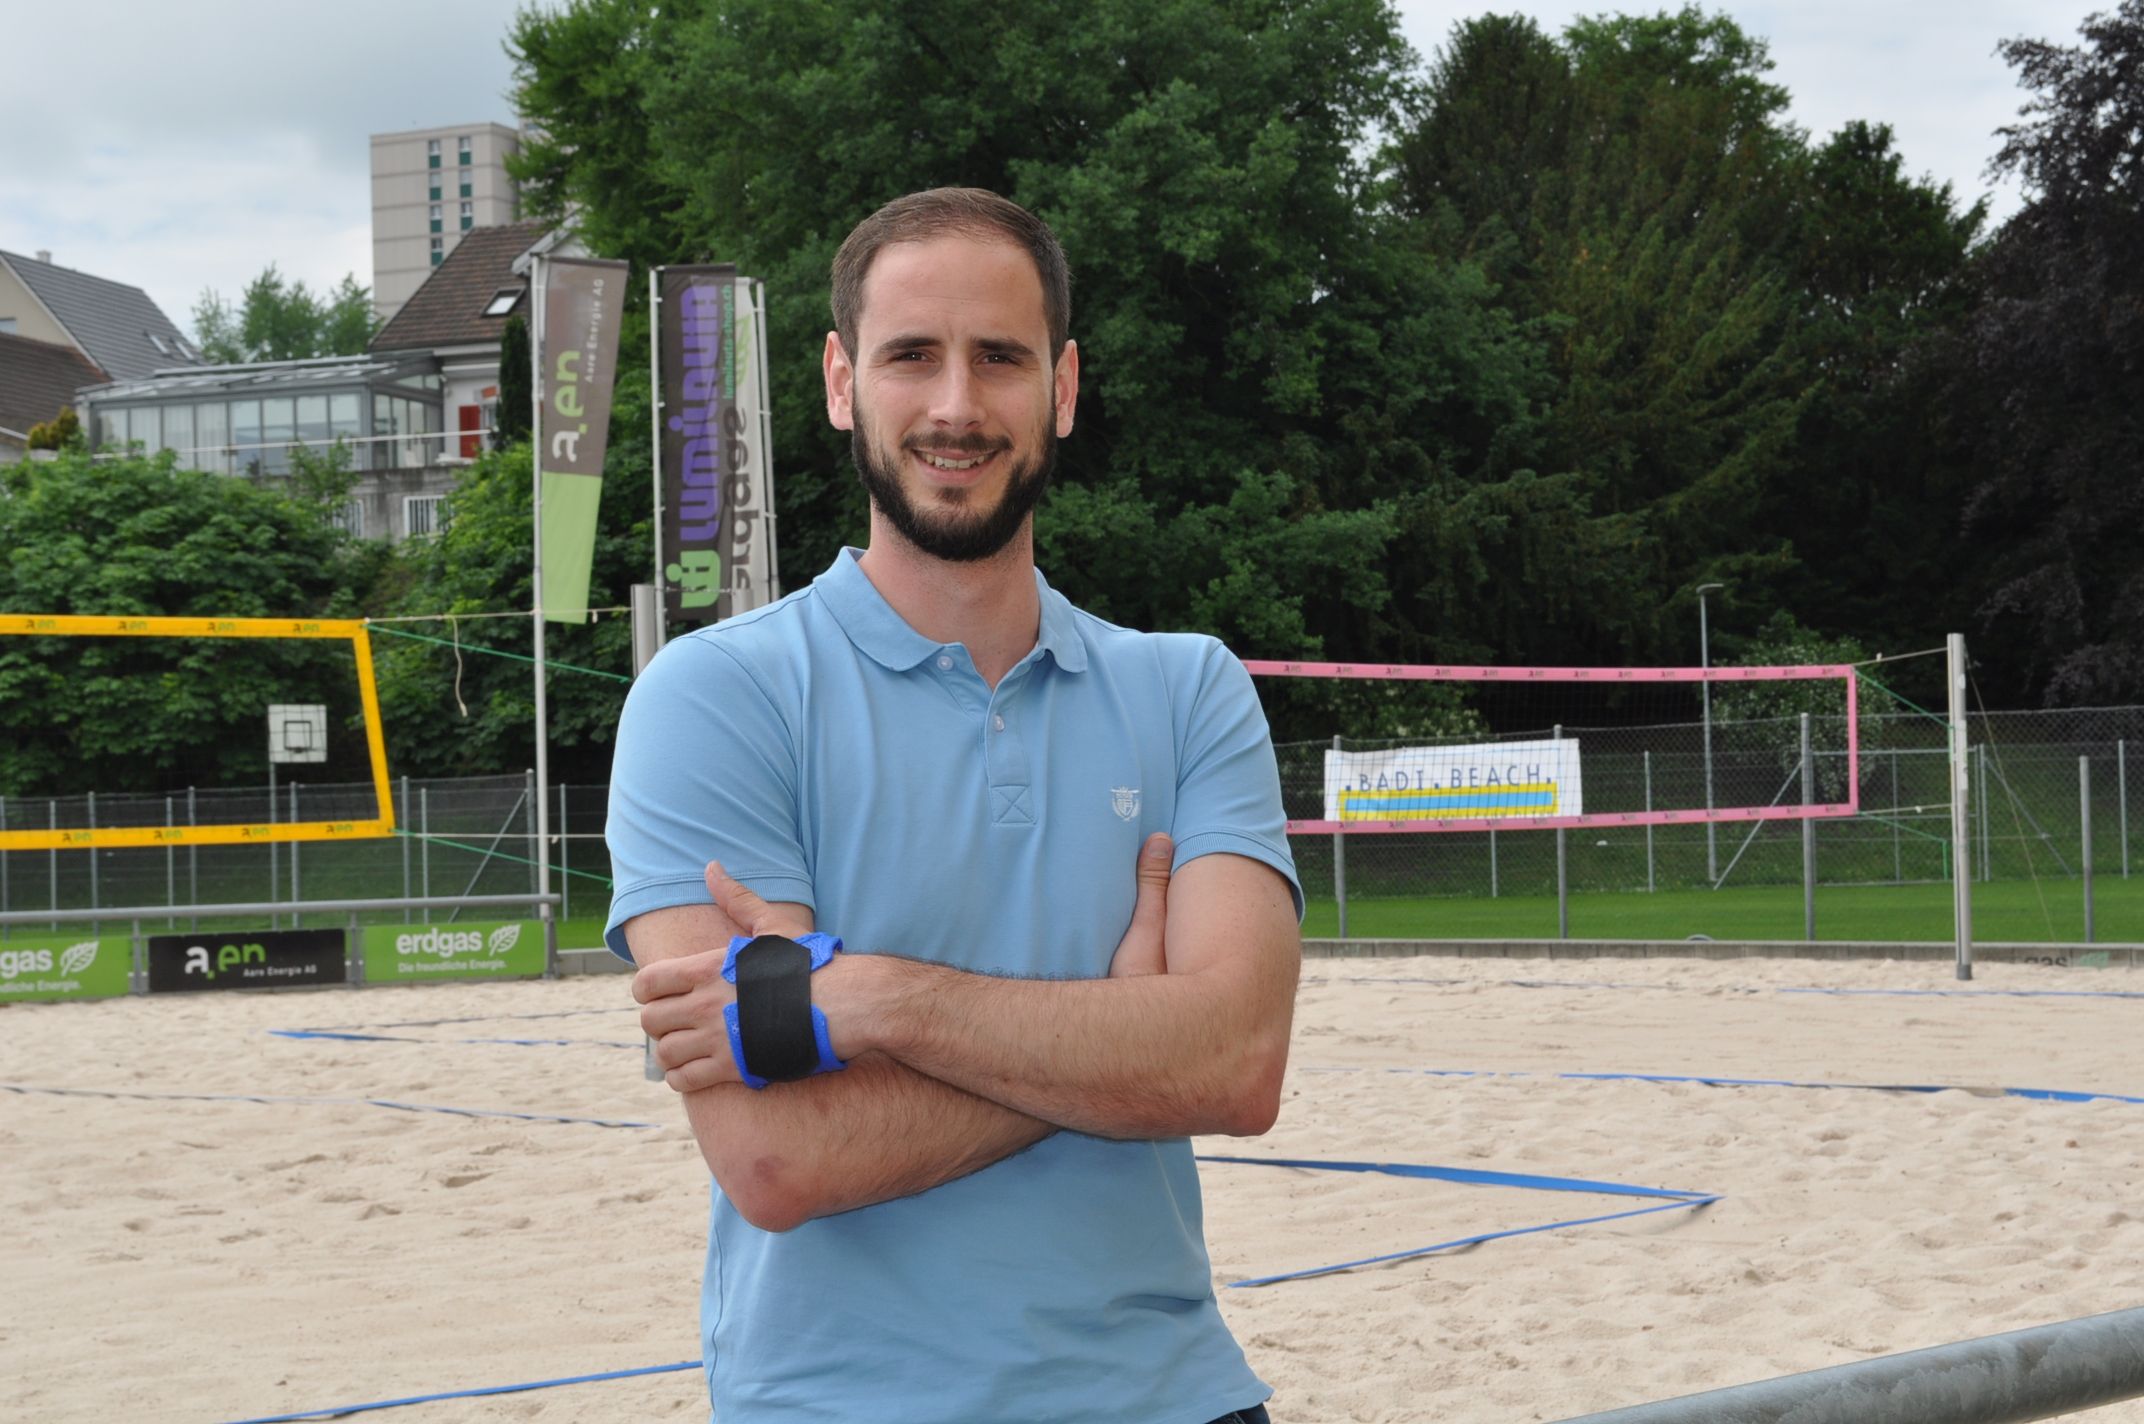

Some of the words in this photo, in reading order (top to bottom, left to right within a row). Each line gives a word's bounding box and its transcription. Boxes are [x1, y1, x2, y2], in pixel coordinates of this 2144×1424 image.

[593, 278, 604, 296] AG
[587, 299, 602, 349] Energie
[585, 353, 597, 383] Aare
[396, 927, 483, 958] erdgas
[243, 967, 265, 977] Aare
[267, 965, 302, 977] Energie
[304, 964, 317, 974] AG
